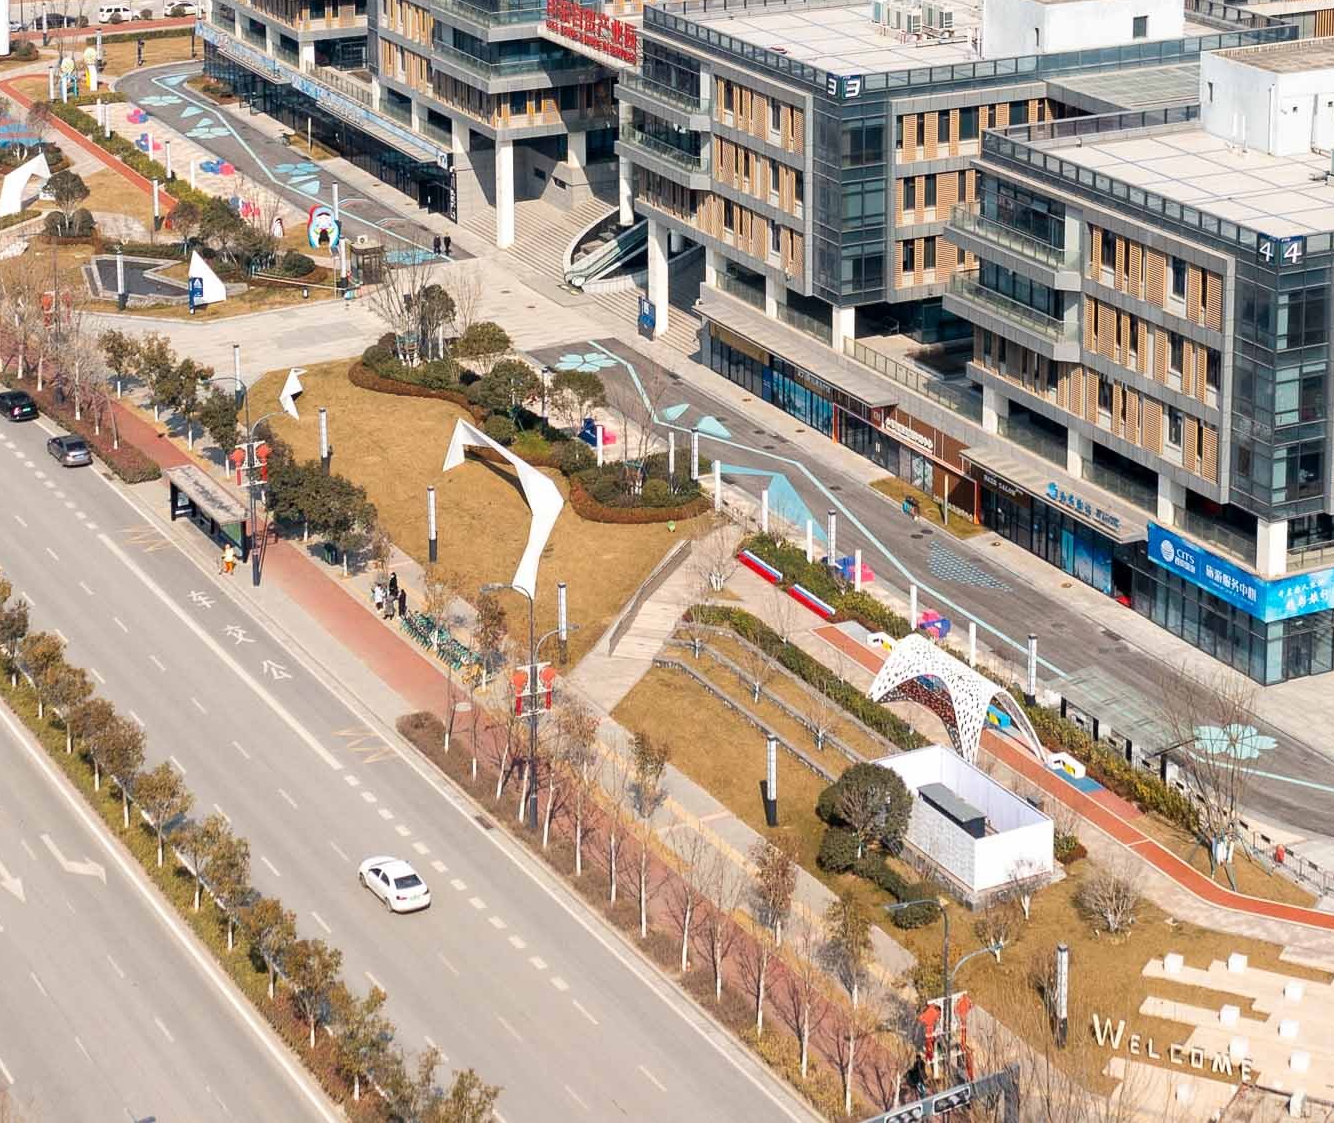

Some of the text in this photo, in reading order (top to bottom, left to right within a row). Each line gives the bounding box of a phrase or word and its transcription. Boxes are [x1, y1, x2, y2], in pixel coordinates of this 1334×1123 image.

[827, 78, 837, 96] 3
[845, 79, 861, 98] 3
[1259, 241, 1274, 262] 4
[1283, 242, 1303, 264] 4
[1176, 548, 1196, 565] CITS
